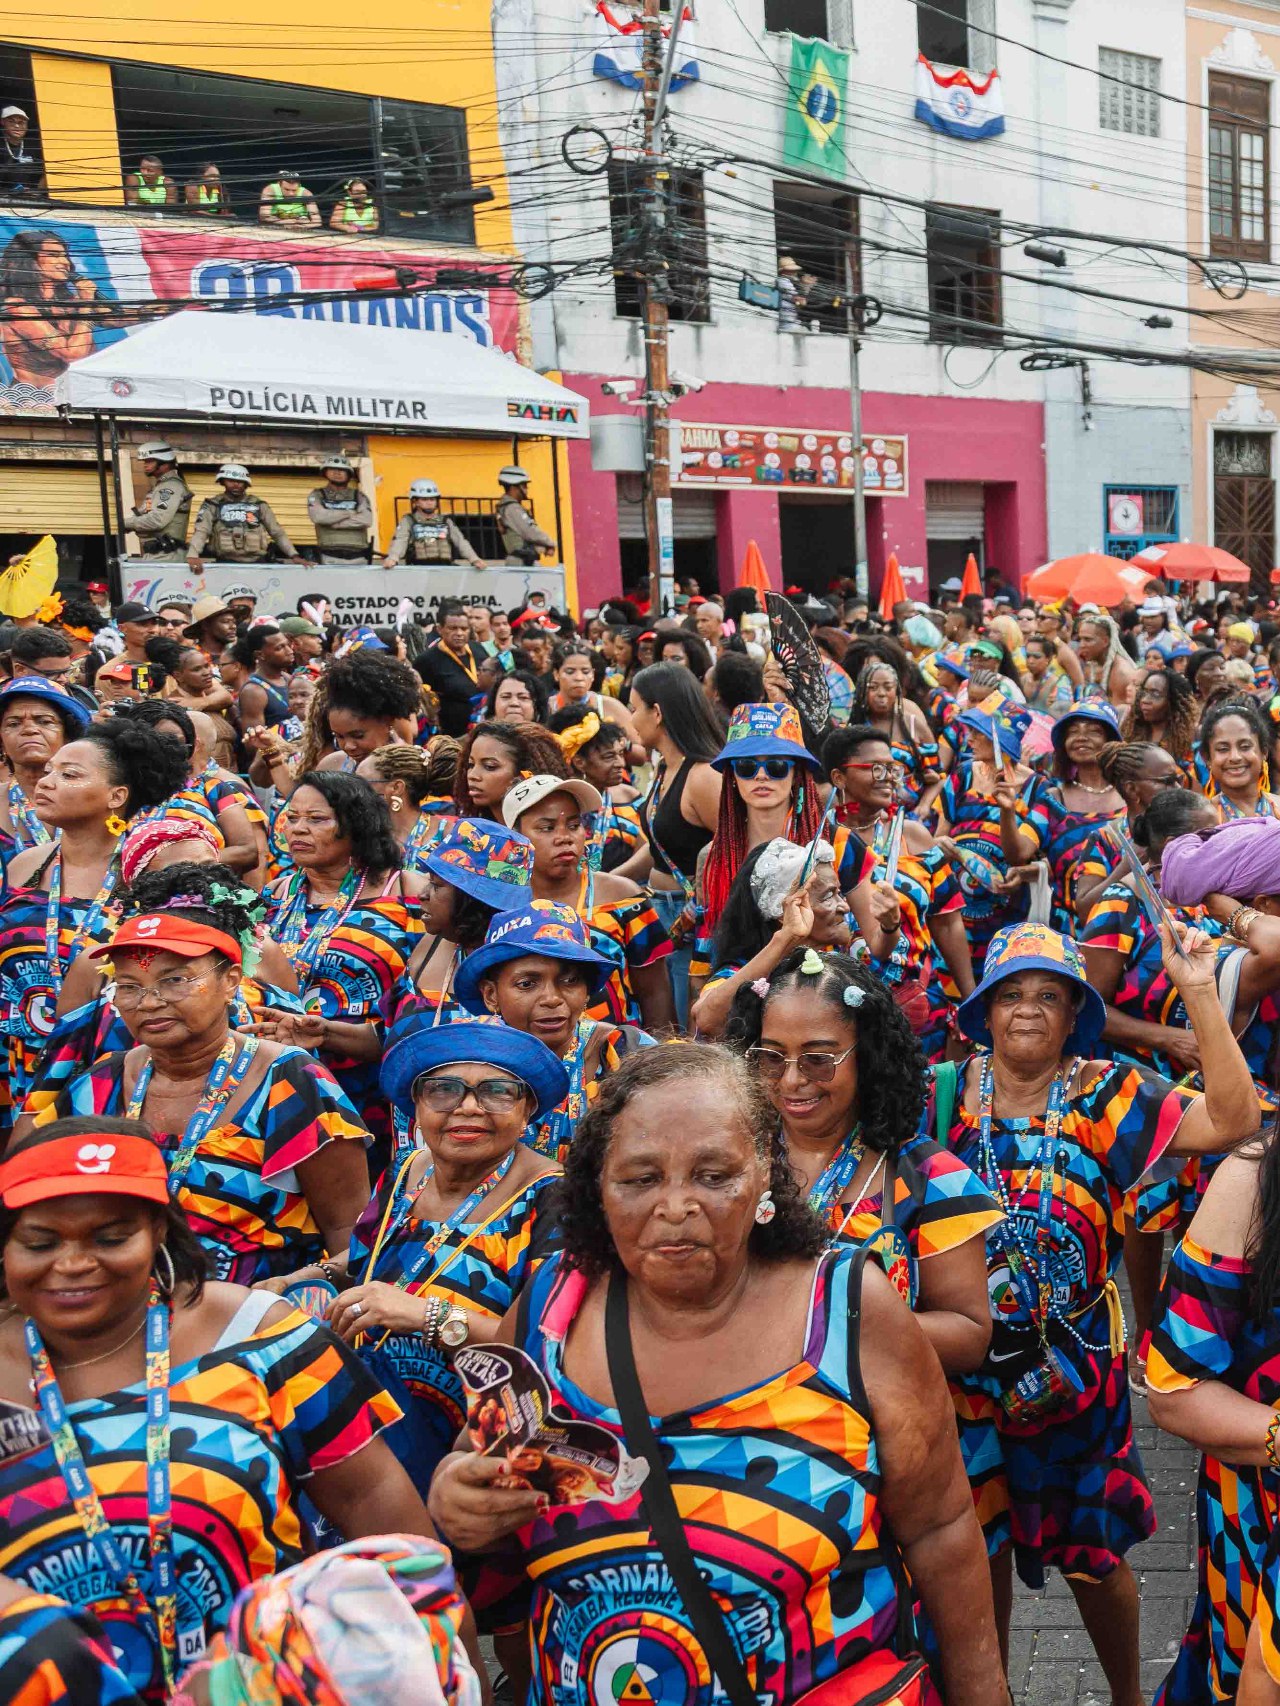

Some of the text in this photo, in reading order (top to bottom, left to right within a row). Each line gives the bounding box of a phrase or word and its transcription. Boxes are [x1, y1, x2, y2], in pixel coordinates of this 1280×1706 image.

[210, 387, 428, 420] POLÍCIA MILITAR
[507, 402, 578, 423] BAHIA
[680, 428, 722, 449] RAHMA
[332, 612, 389, 626] NAVAL
[490, 916, 532, 943] CAIXA
[842, 1161, 853, 1179] CAIXA
[1063, 1243, 1084, 1282] 2026
[457, 1356, 497, 1385] DELAS
[570, 1563, 677, 1593] CARNAV
[577, 1592, 608, 1639] SAMBA
[742, 1601, 772, 1654] 026
